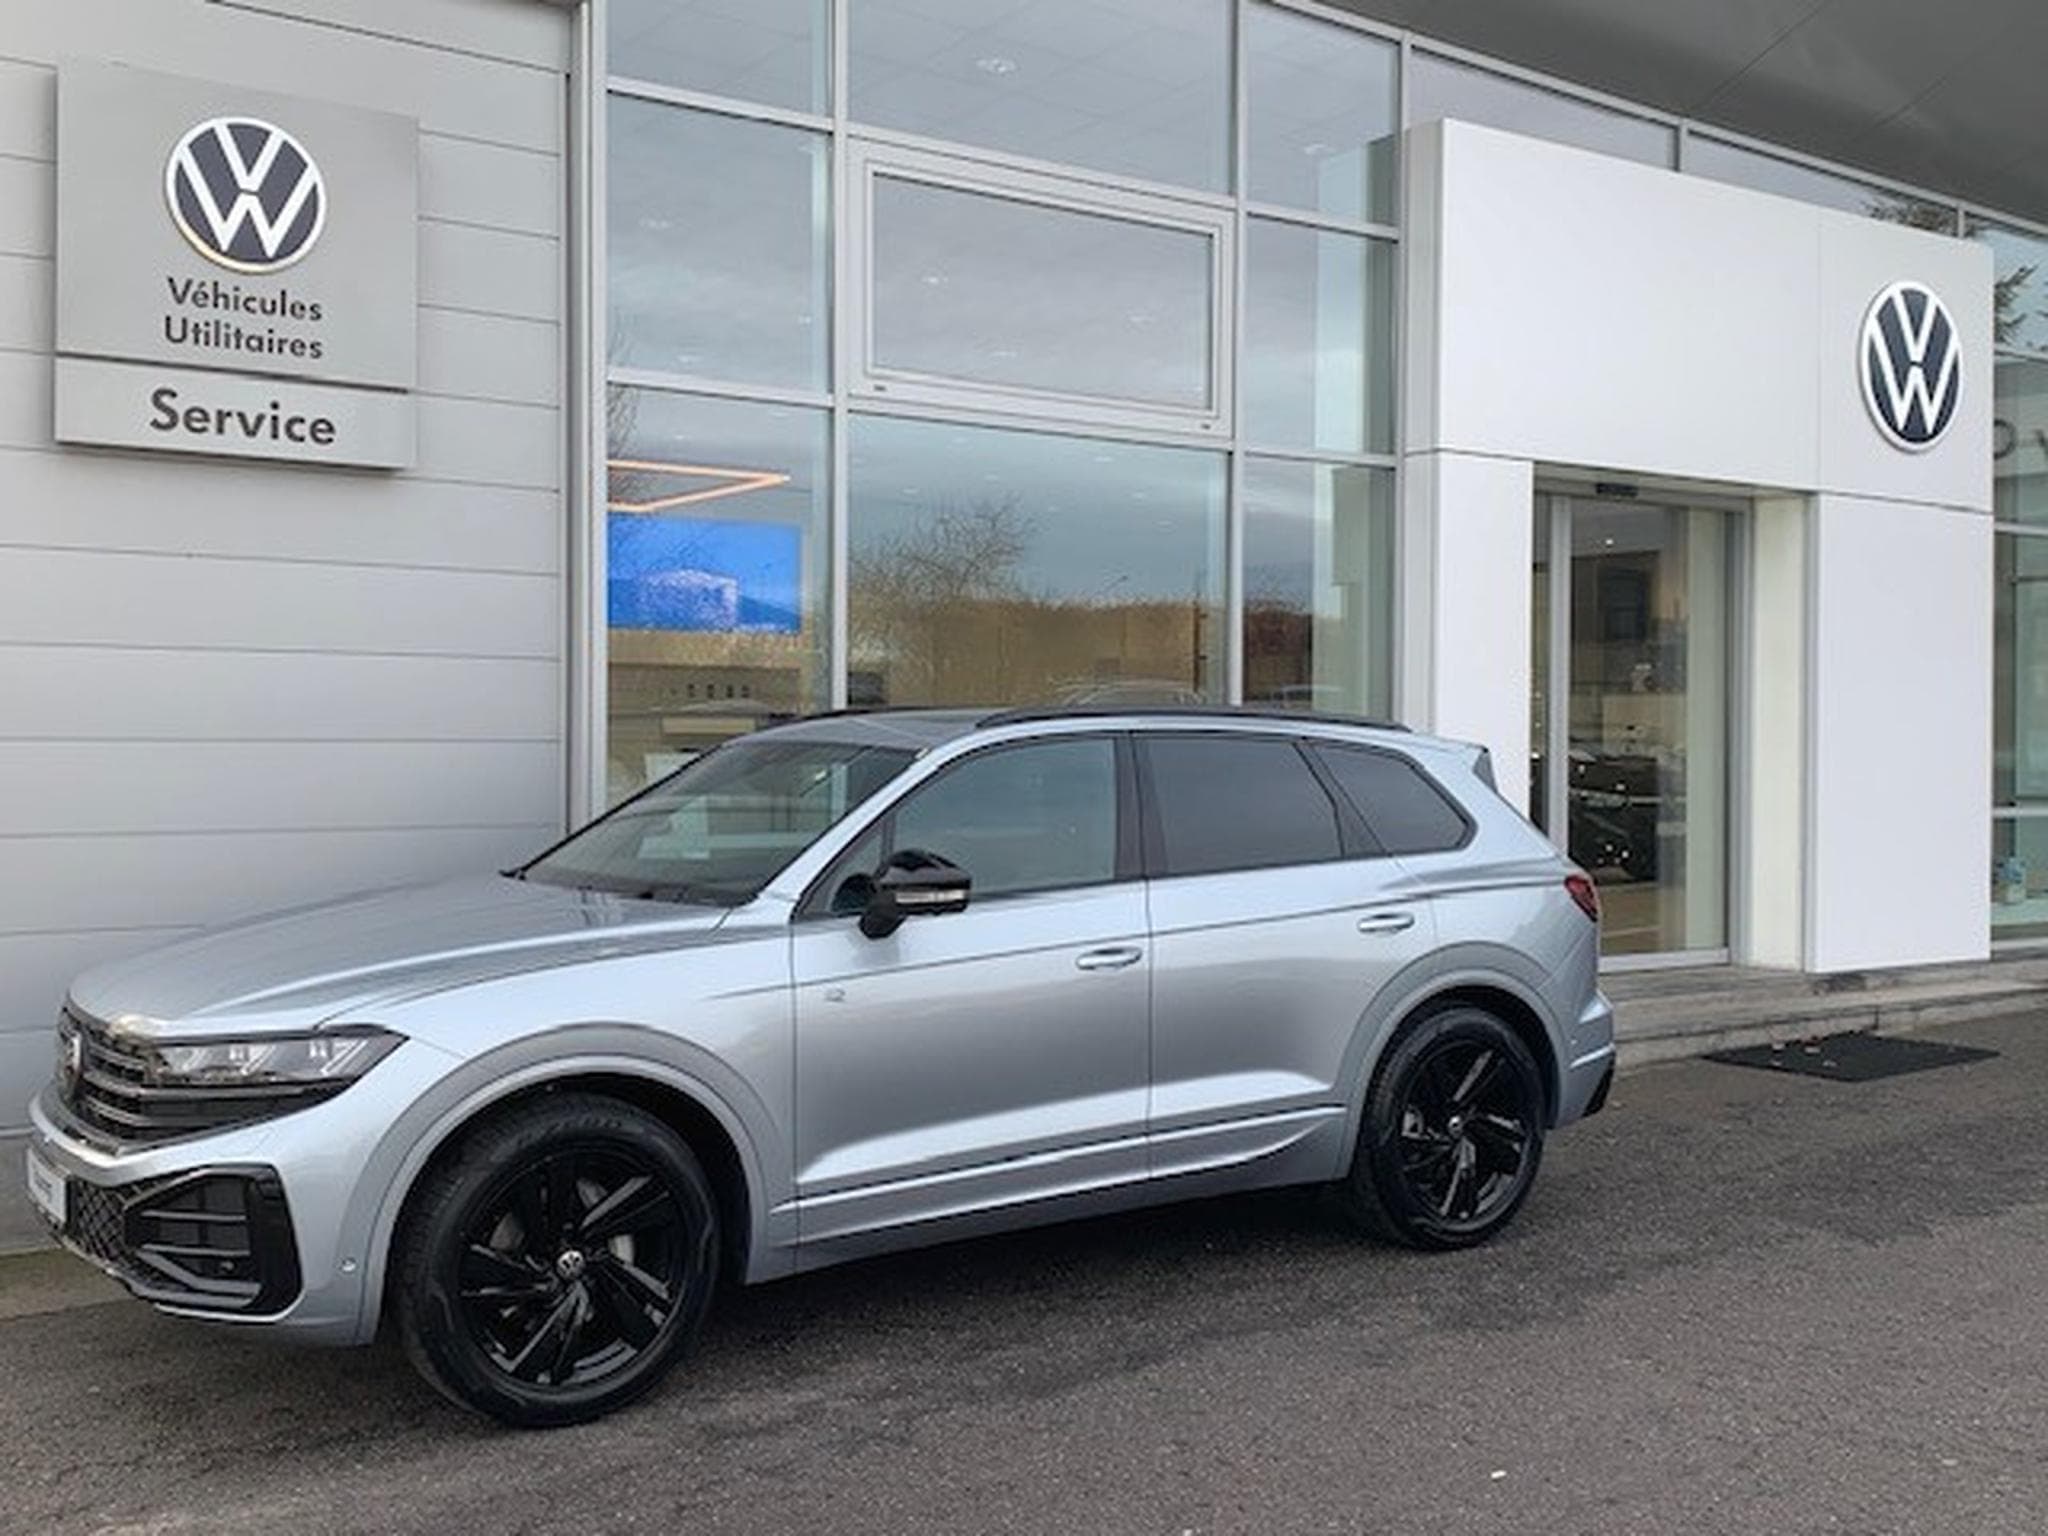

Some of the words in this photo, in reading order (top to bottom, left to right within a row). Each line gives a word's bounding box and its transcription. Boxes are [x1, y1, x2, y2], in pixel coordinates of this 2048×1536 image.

[167, 276, 322, 321] Véhicules
[164, 315, 323, 359] Utilitaires
[150, 387, 337, 445] Service
